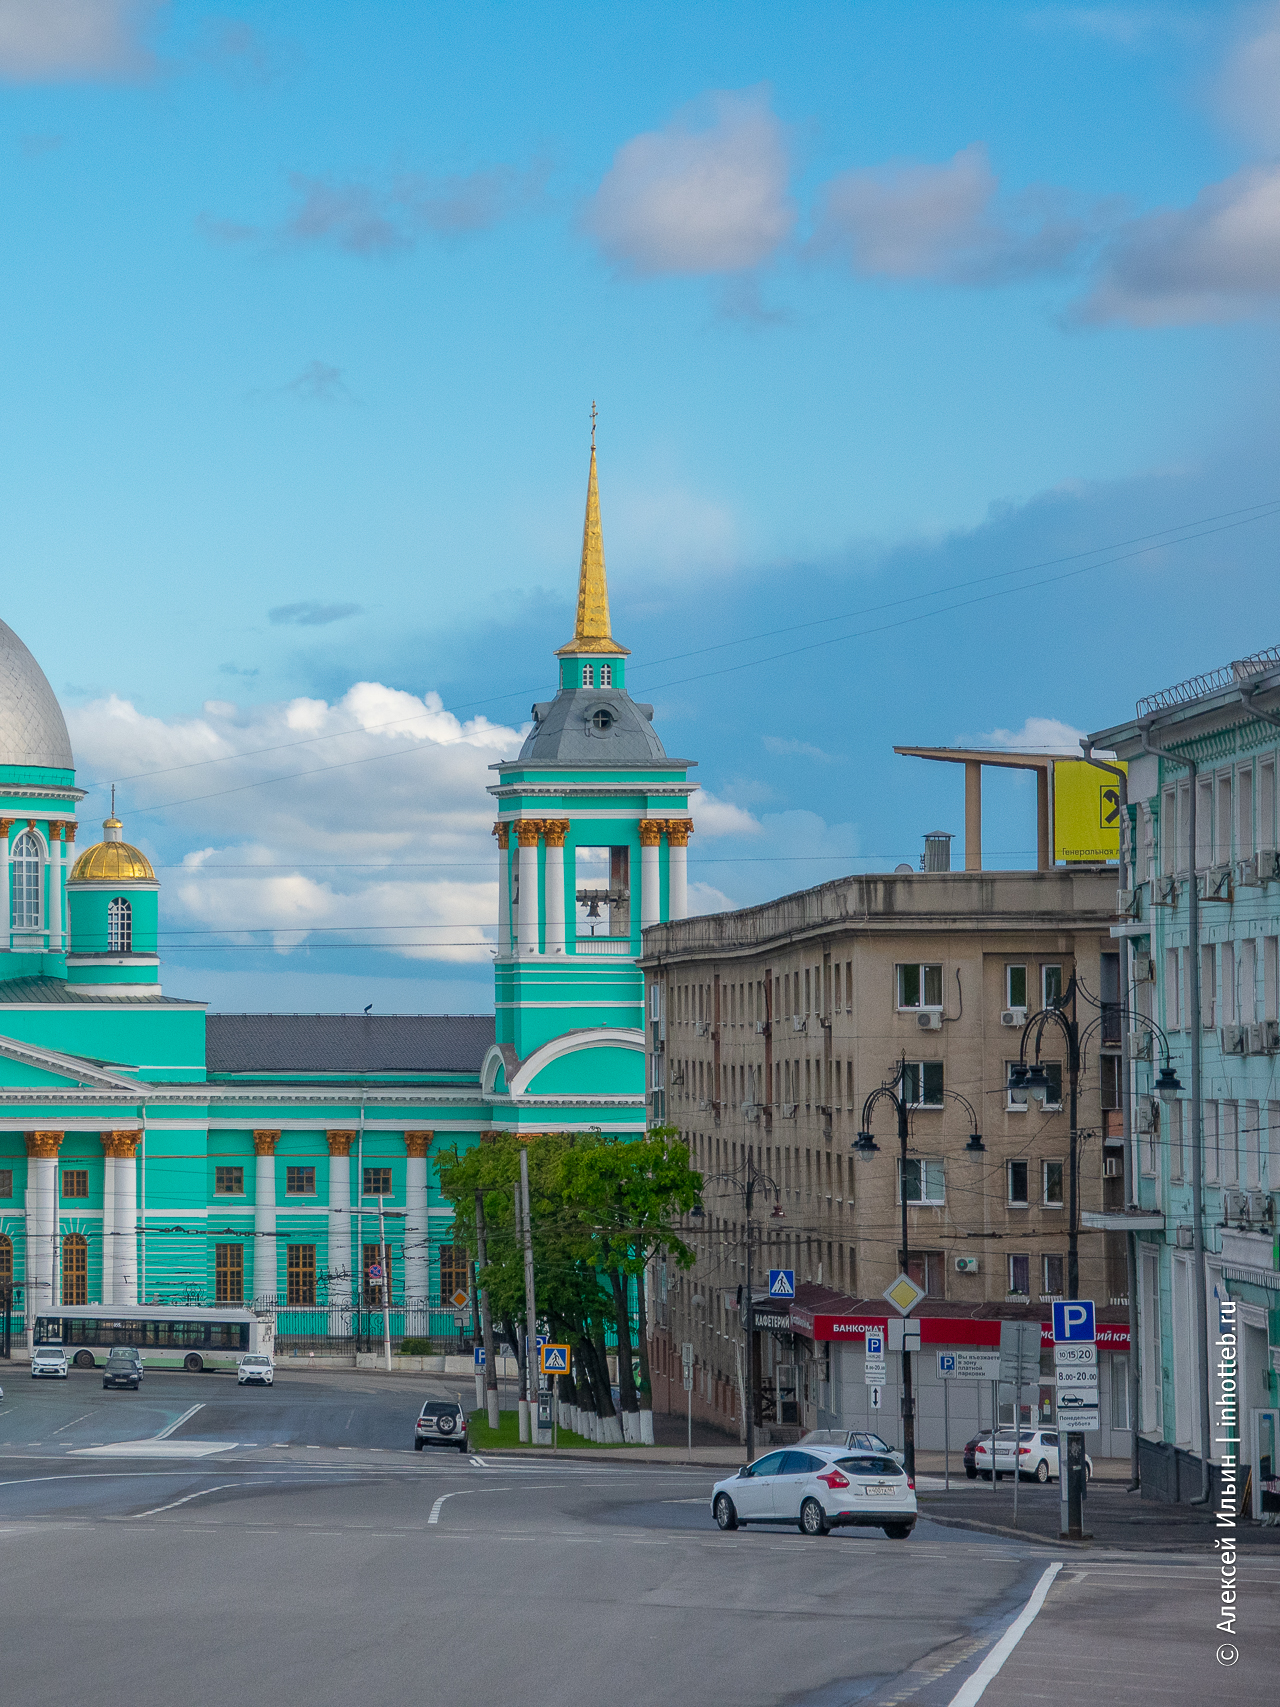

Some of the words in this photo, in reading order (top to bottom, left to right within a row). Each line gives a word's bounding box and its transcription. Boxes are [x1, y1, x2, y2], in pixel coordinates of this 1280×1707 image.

[1062, 847, 1113, 857] Генеральная
[754, 1314, 790, 1329] КАФЕТЕРИЙ
[1064, 1305, 1087, 1338] P
[833, 1324, 885, 1333] БАНКОМАТ
[1068, 1350, 1076, 1359] 15
[1078, 1349, 1091, 1359] 20
